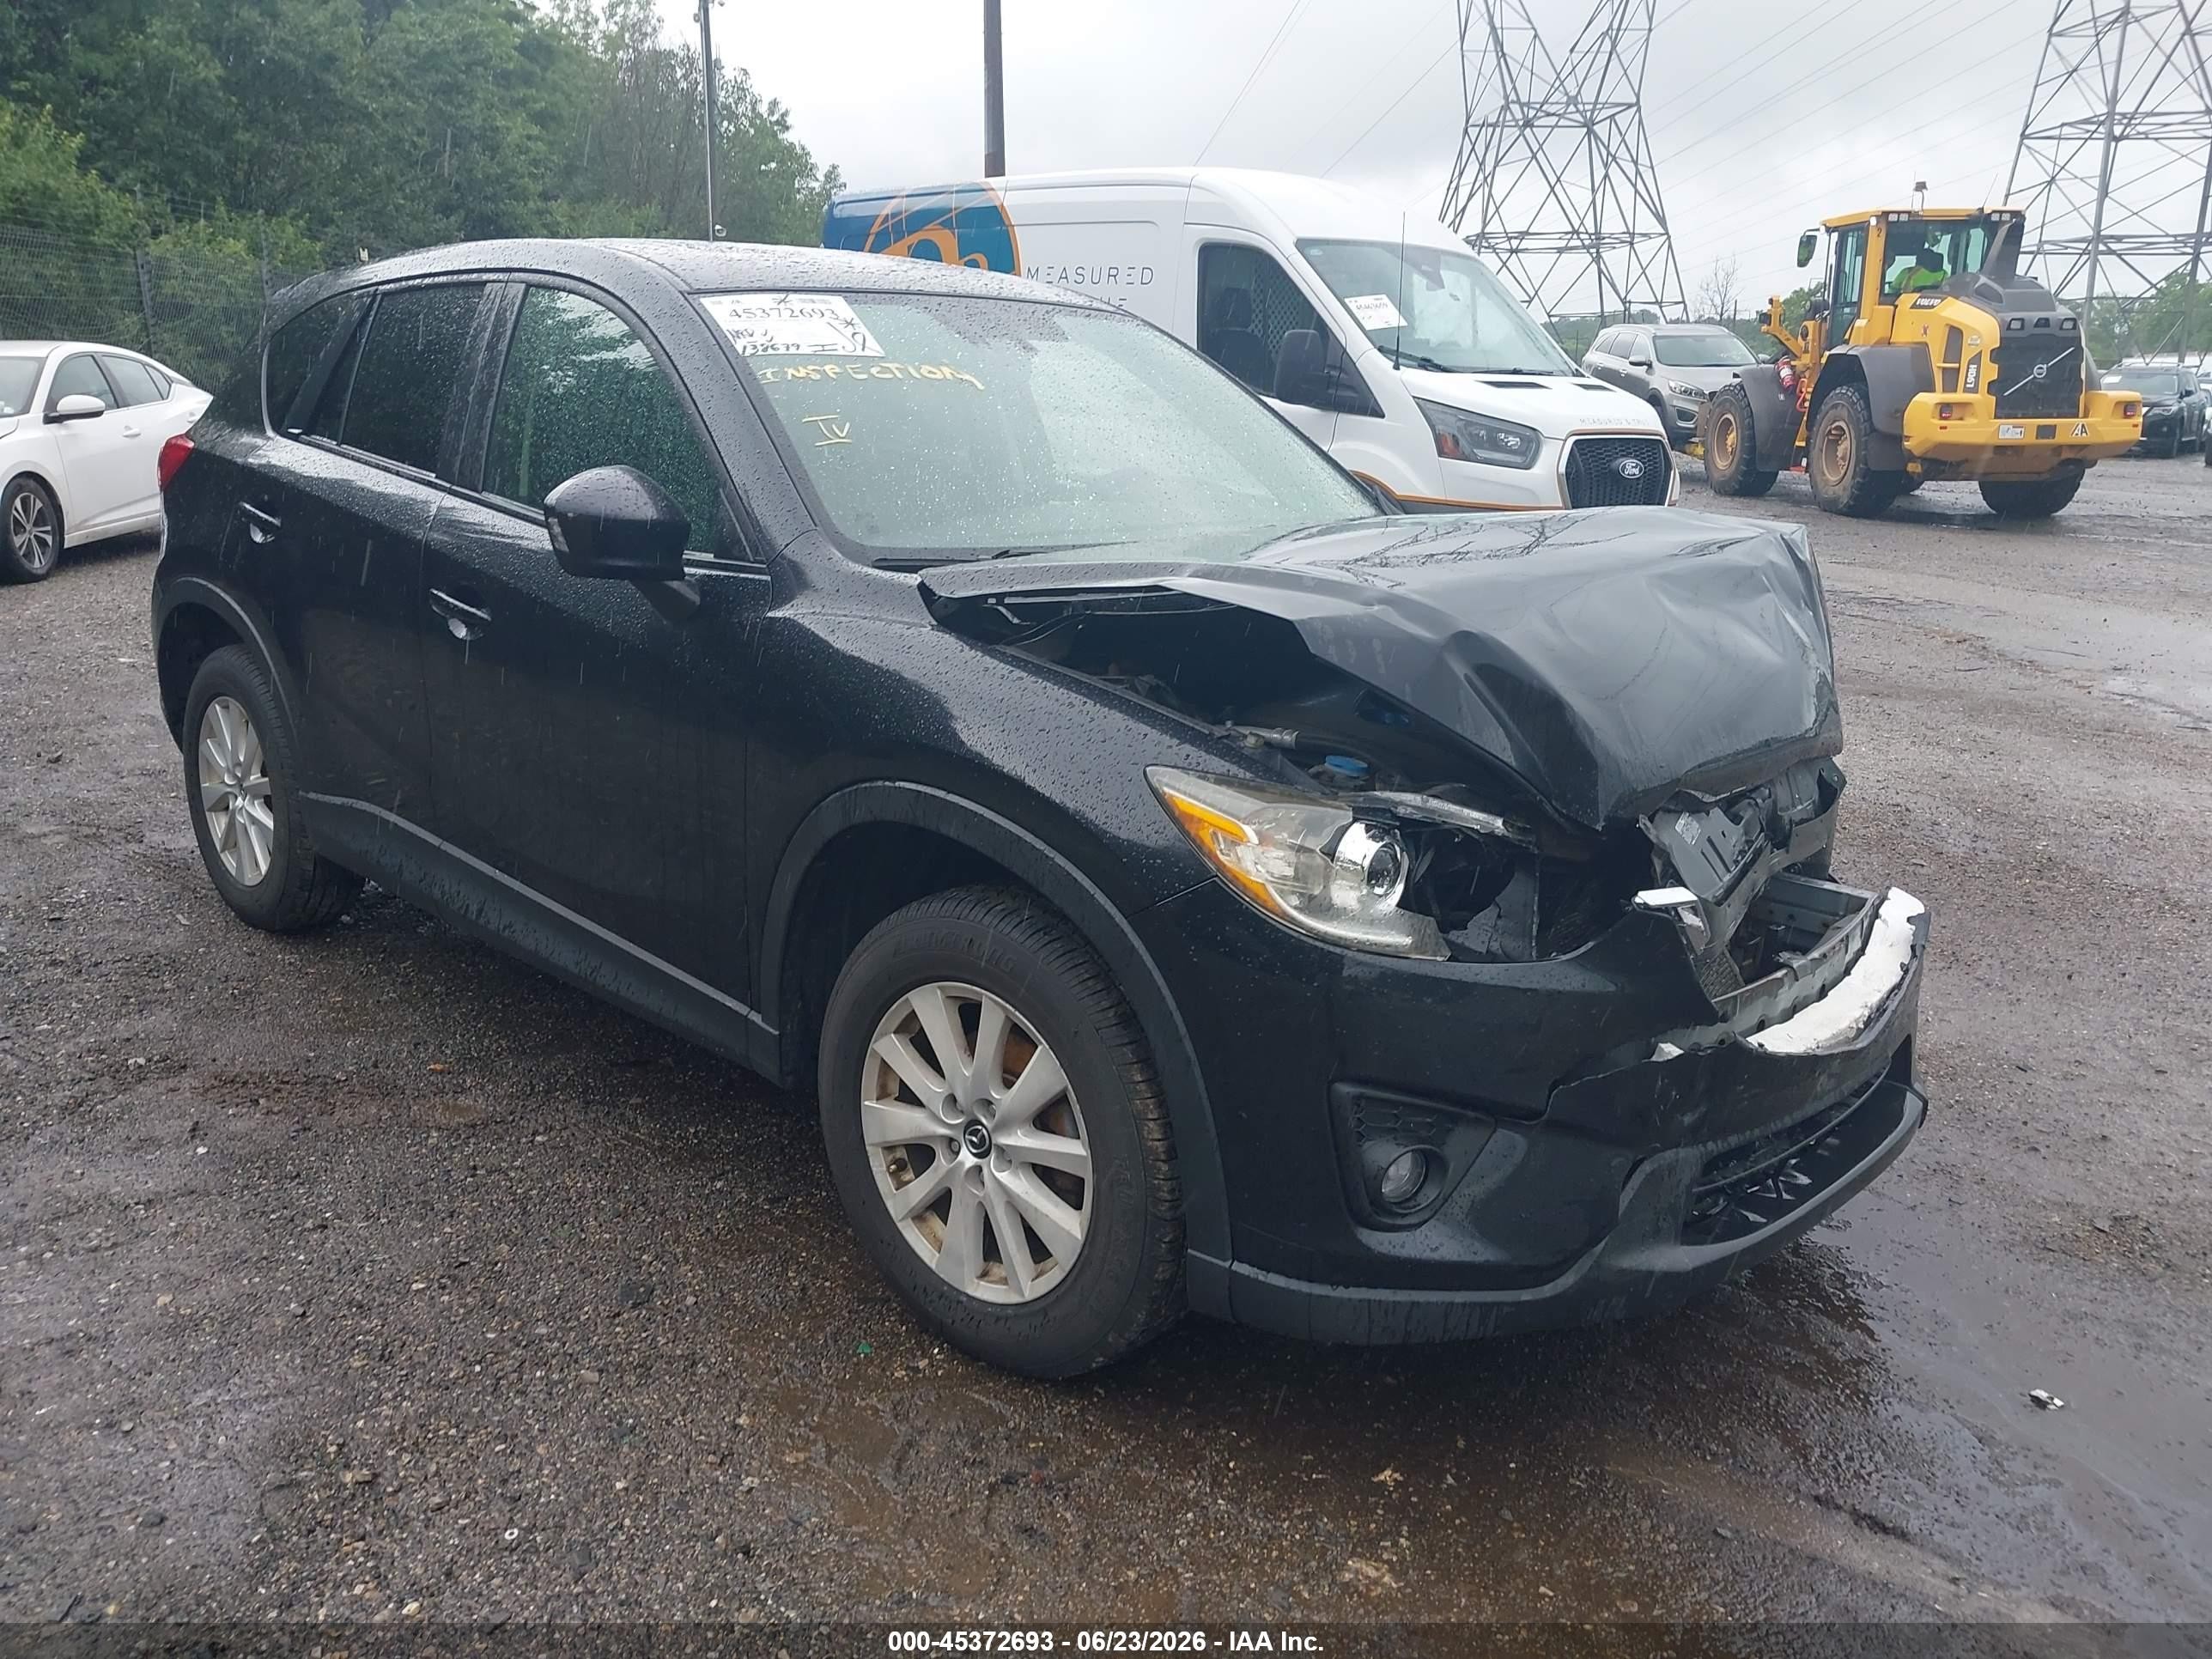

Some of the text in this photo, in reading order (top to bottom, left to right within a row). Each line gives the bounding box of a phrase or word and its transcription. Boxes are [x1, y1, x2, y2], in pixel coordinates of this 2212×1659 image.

[1025, 266, 1154, 285] MEASURED
[1916, 297, 1942, 307] VOLVO
[757, 362, 985, 390] INSPECTION
[1966, 363, 1978, 388] L90H
[1624, 463, 1640, 475] Ford
